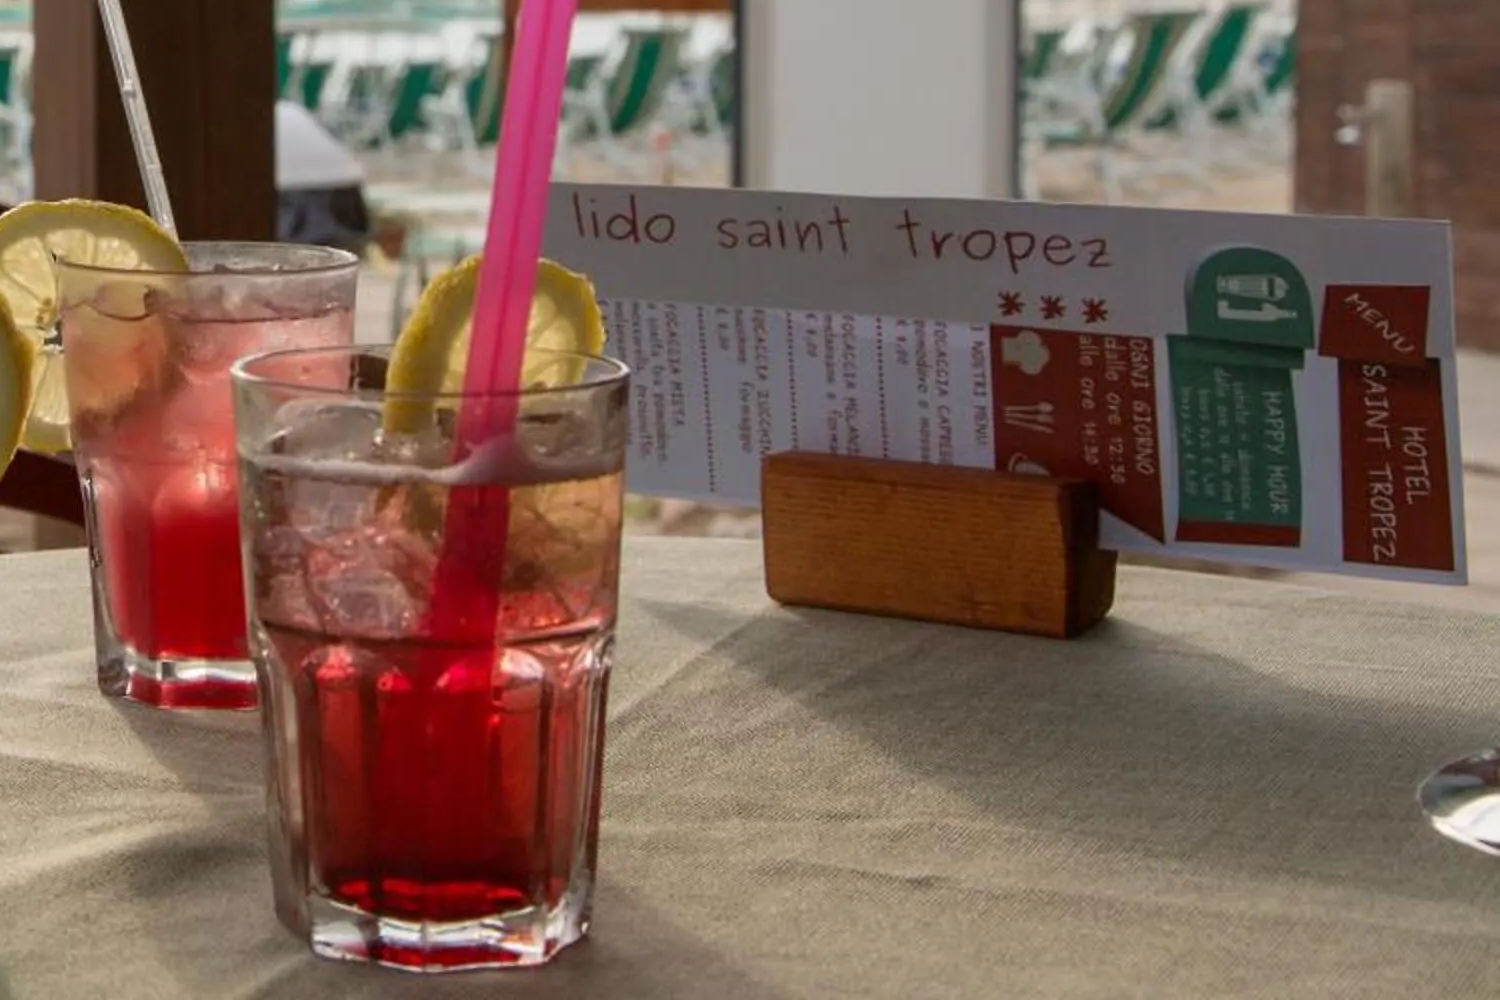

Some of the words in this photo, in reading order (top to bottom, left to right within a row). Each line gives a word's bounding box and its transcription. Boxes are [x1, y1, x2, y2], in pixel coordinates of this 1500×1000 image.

[572, 192, 676, 244] lido
[716, 205, 851, 254] saint
[895, 208, 1114, 273] tropez
[664, 303, 680, 374] FOCACCIA
[752, 308, 768, 381] FOCACCIA
[841, 314, 856, 389] FOCACCIA
[1078, 335, 1097, 366] alle
[1344, 292, 1416, 353] MENU
[933, 321, 948, 397] FOCACCIA
[970, 341, 986, 397] NOSTRI
[1104, 336, 1126, 381] dalle
[1128, 339, 1149, 388] OGNI
[670, 381, 684, 426] MISTA
[756, 390, 772, 459] ZUCCHIN
[1079, 378, 1095, 409] ore
[1106, 392, 1121, 425] ore
[1260, 391, 1285, 455] HAPPY
[1361, 364, 1390, 449] SAINT
[973, 405, 988, 445] MENU
[1131, 401, 1154, 475] GIORNO
[1108, 437, 1125, 484] 12:30
[1266, 465, 1289, 514] HOUR
[1400, 426, 1431, 505] HOTEL
[1367, 462, 1396, 562] TROPEZ
